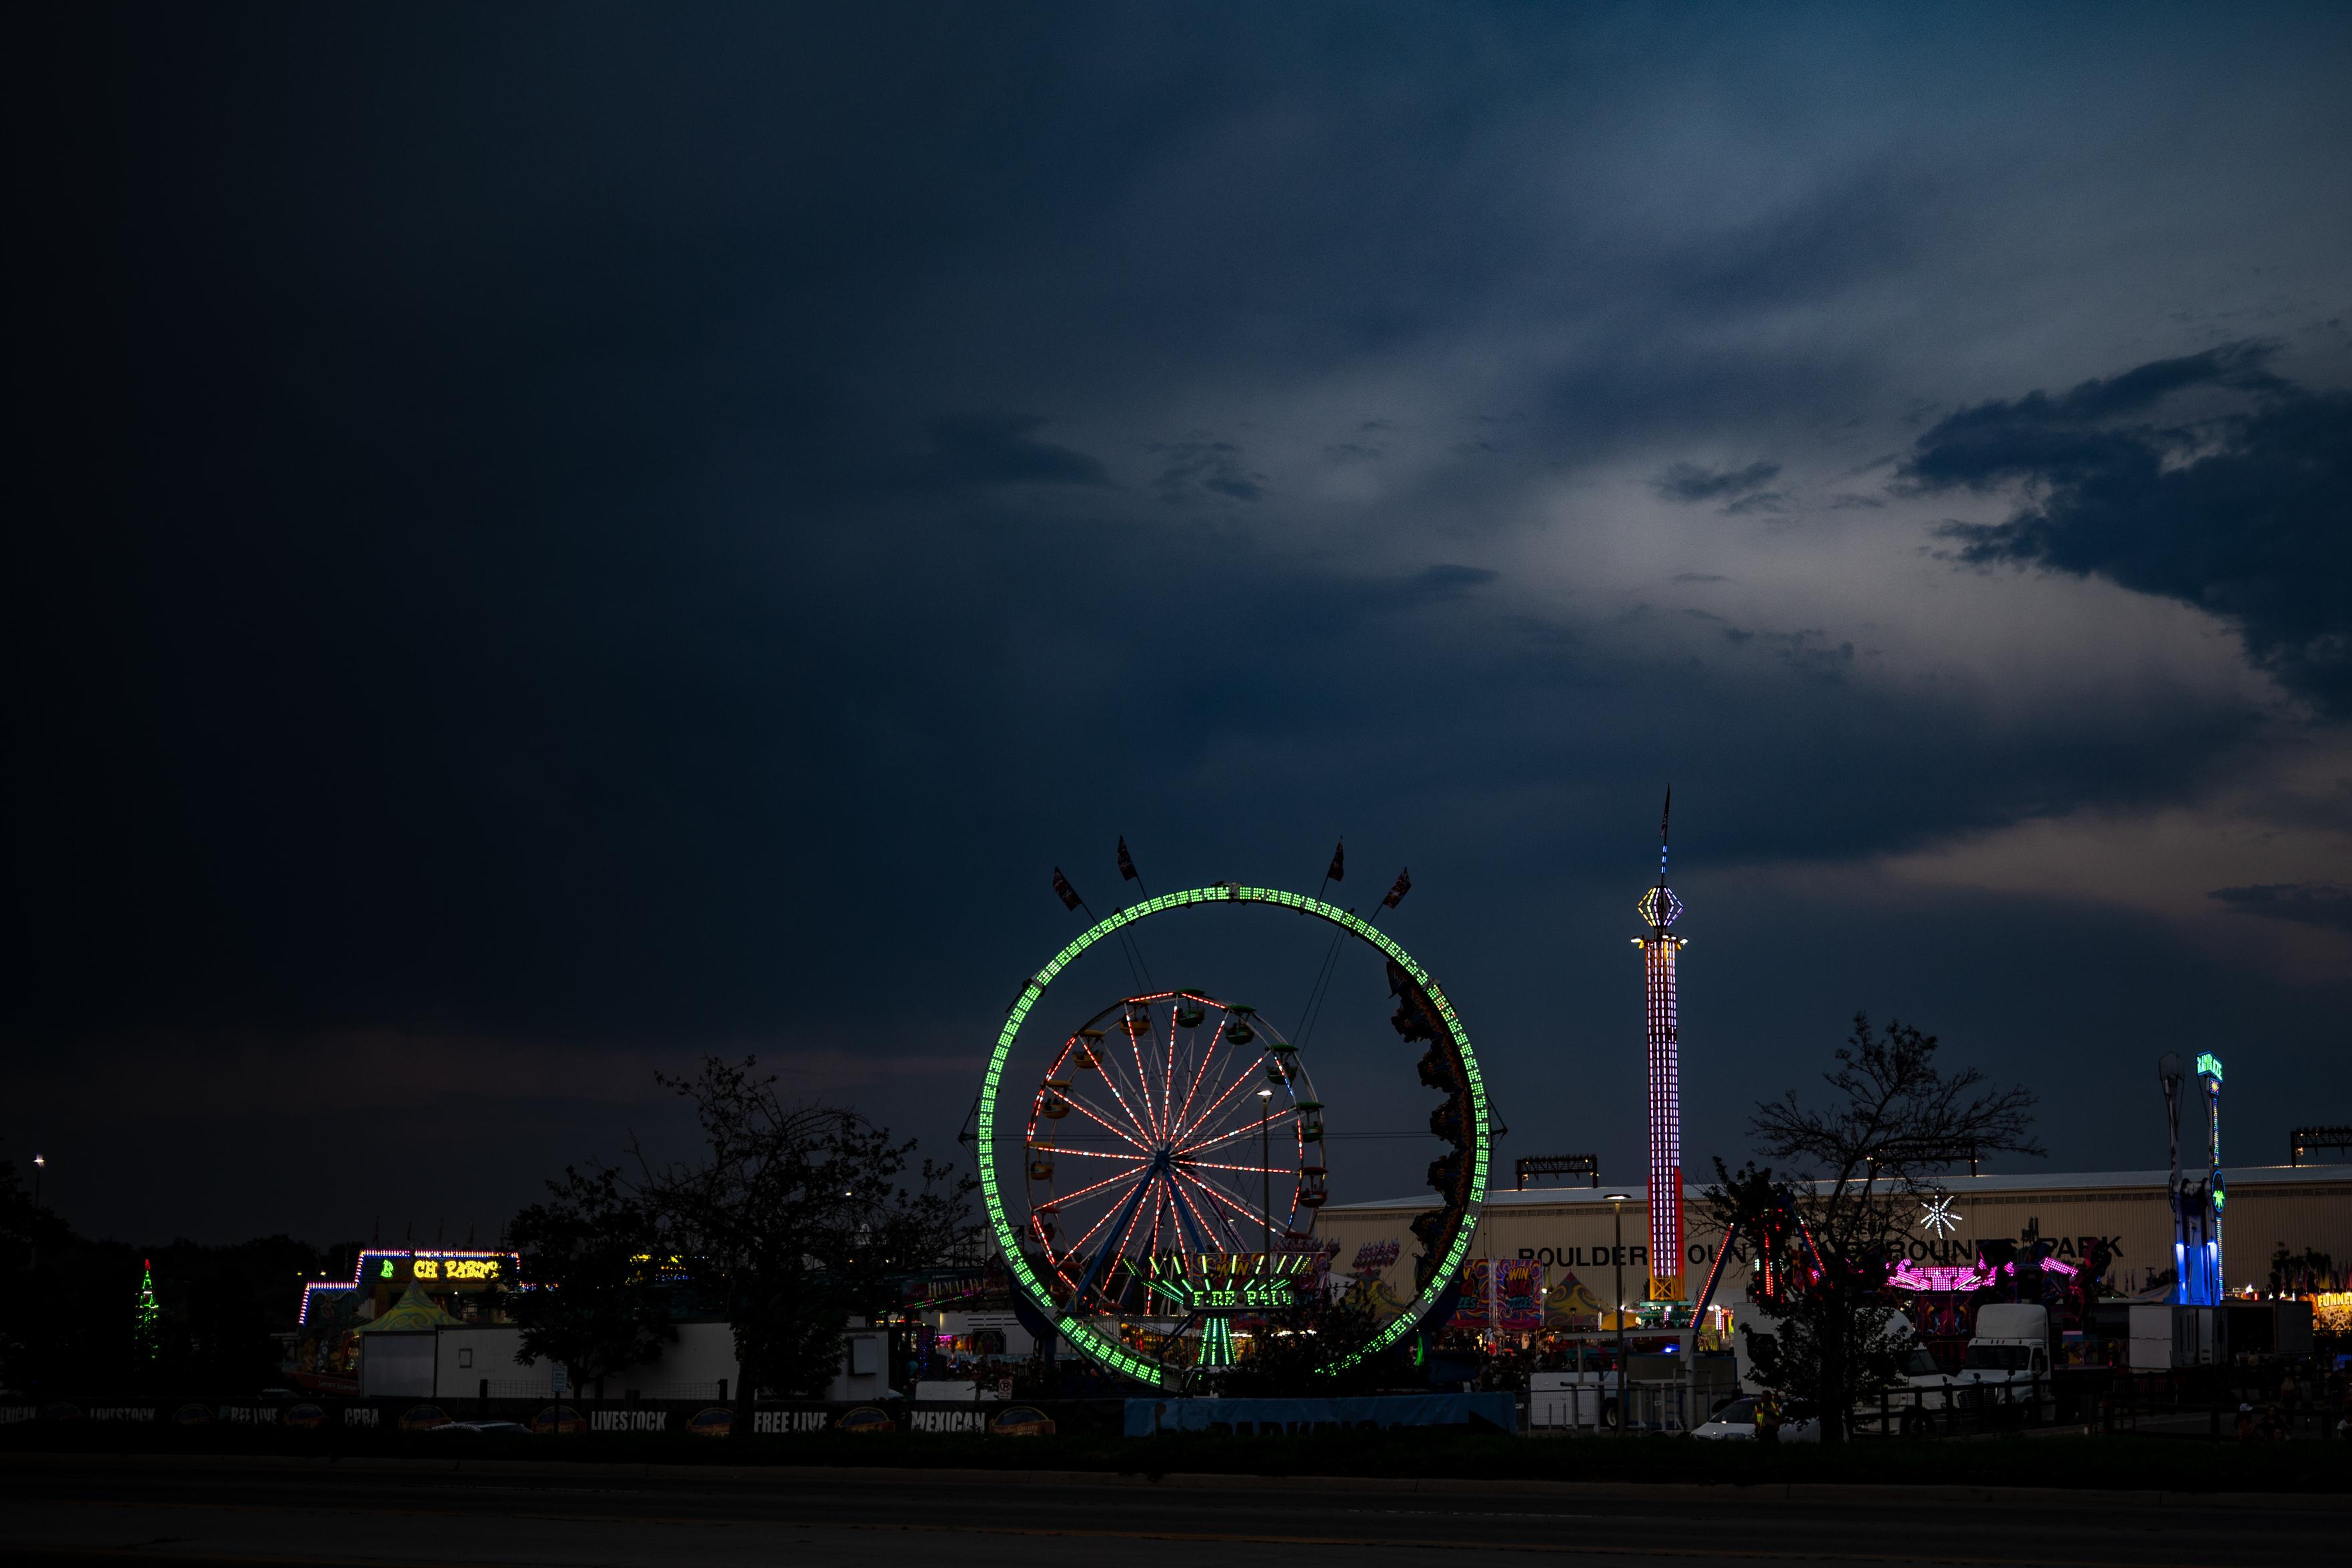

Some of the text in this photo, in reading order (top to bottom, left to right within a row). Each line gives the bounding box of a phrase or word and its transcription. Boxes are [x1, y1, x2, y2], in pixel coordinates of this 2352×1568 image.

[1508, 1267, 1530, 1281] WIN
[90, 1407, 155, 1423] LIVESTOCK
[253, 1407, 278, 1425] LIVE
[344, 1407, 379, 1427] CPRA
[590, 1410, 667, 1431] LIVESTOCK
[753, 1411, 790, 1433] FREE
[792, 1411, 828, 1433] LIVE
[910, 1411, 986, 1433] MEXICAN
